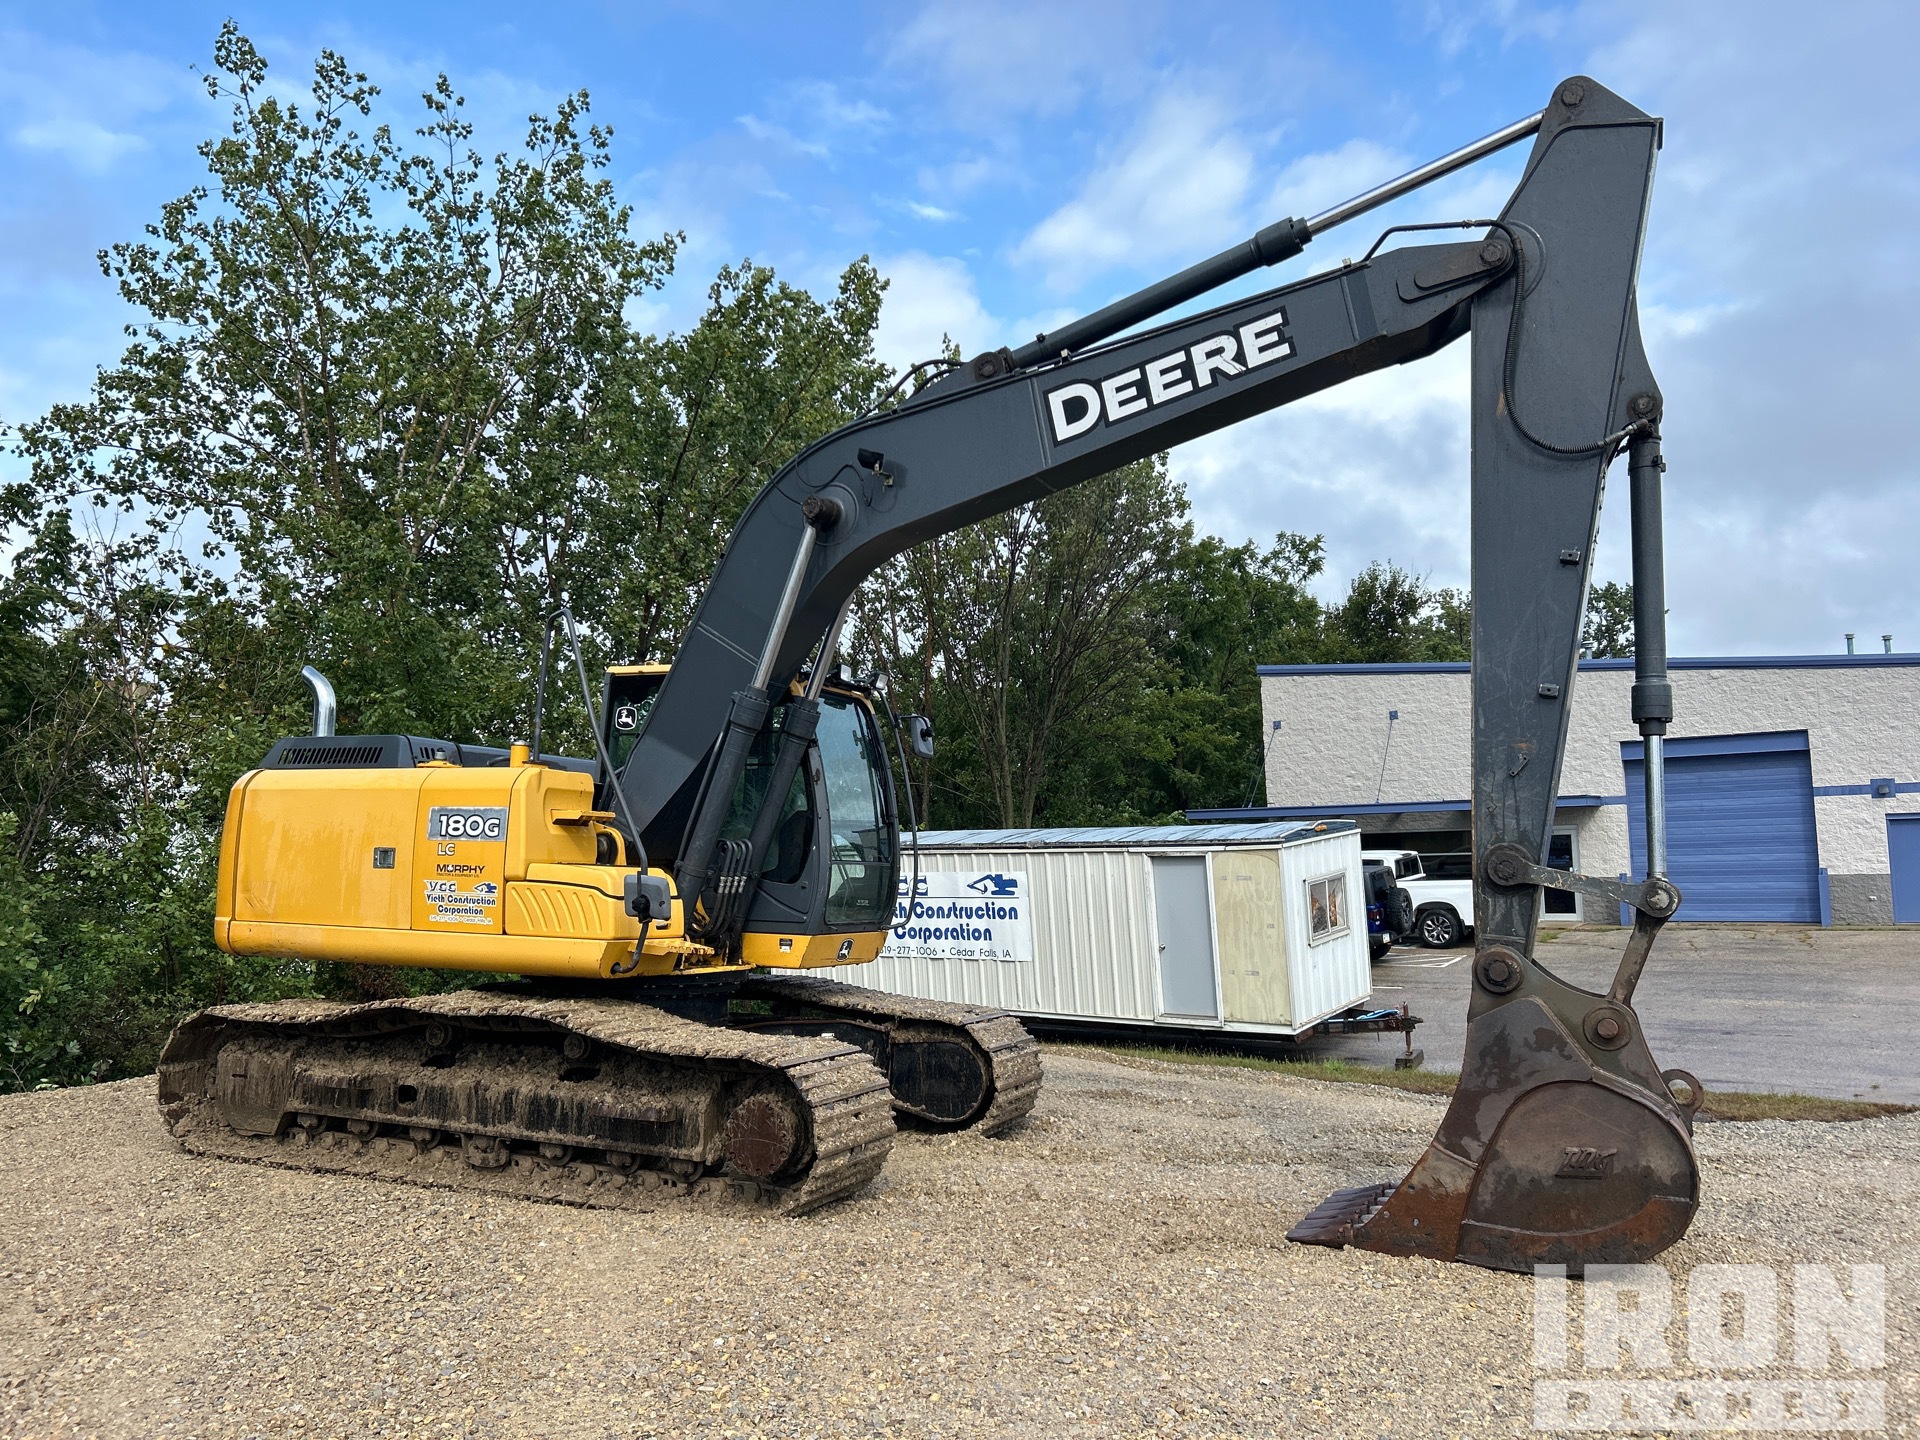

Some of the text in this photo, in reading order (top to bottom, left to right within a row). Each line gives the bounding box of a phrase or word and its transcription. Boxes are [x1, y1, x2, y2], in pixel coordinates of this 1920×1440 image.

[1048, 312, 1290, 441] DEERE
[439, 815, 500, 837] 180G
[437, 843, 455, 856] LC
[436, 864, 485, 874] MURPHY
[427, 894, 496, 906] Vieth Construction
[438, 904, 483, 916] Corporation
[913, 901, 1018, 920] Construction
[894, 923, 992, 944] Corporation
[949, 946, 975, 957] Cedar
[979, 948, 999, 959] Falls,
[1002, 949, 1012, 958] IA
